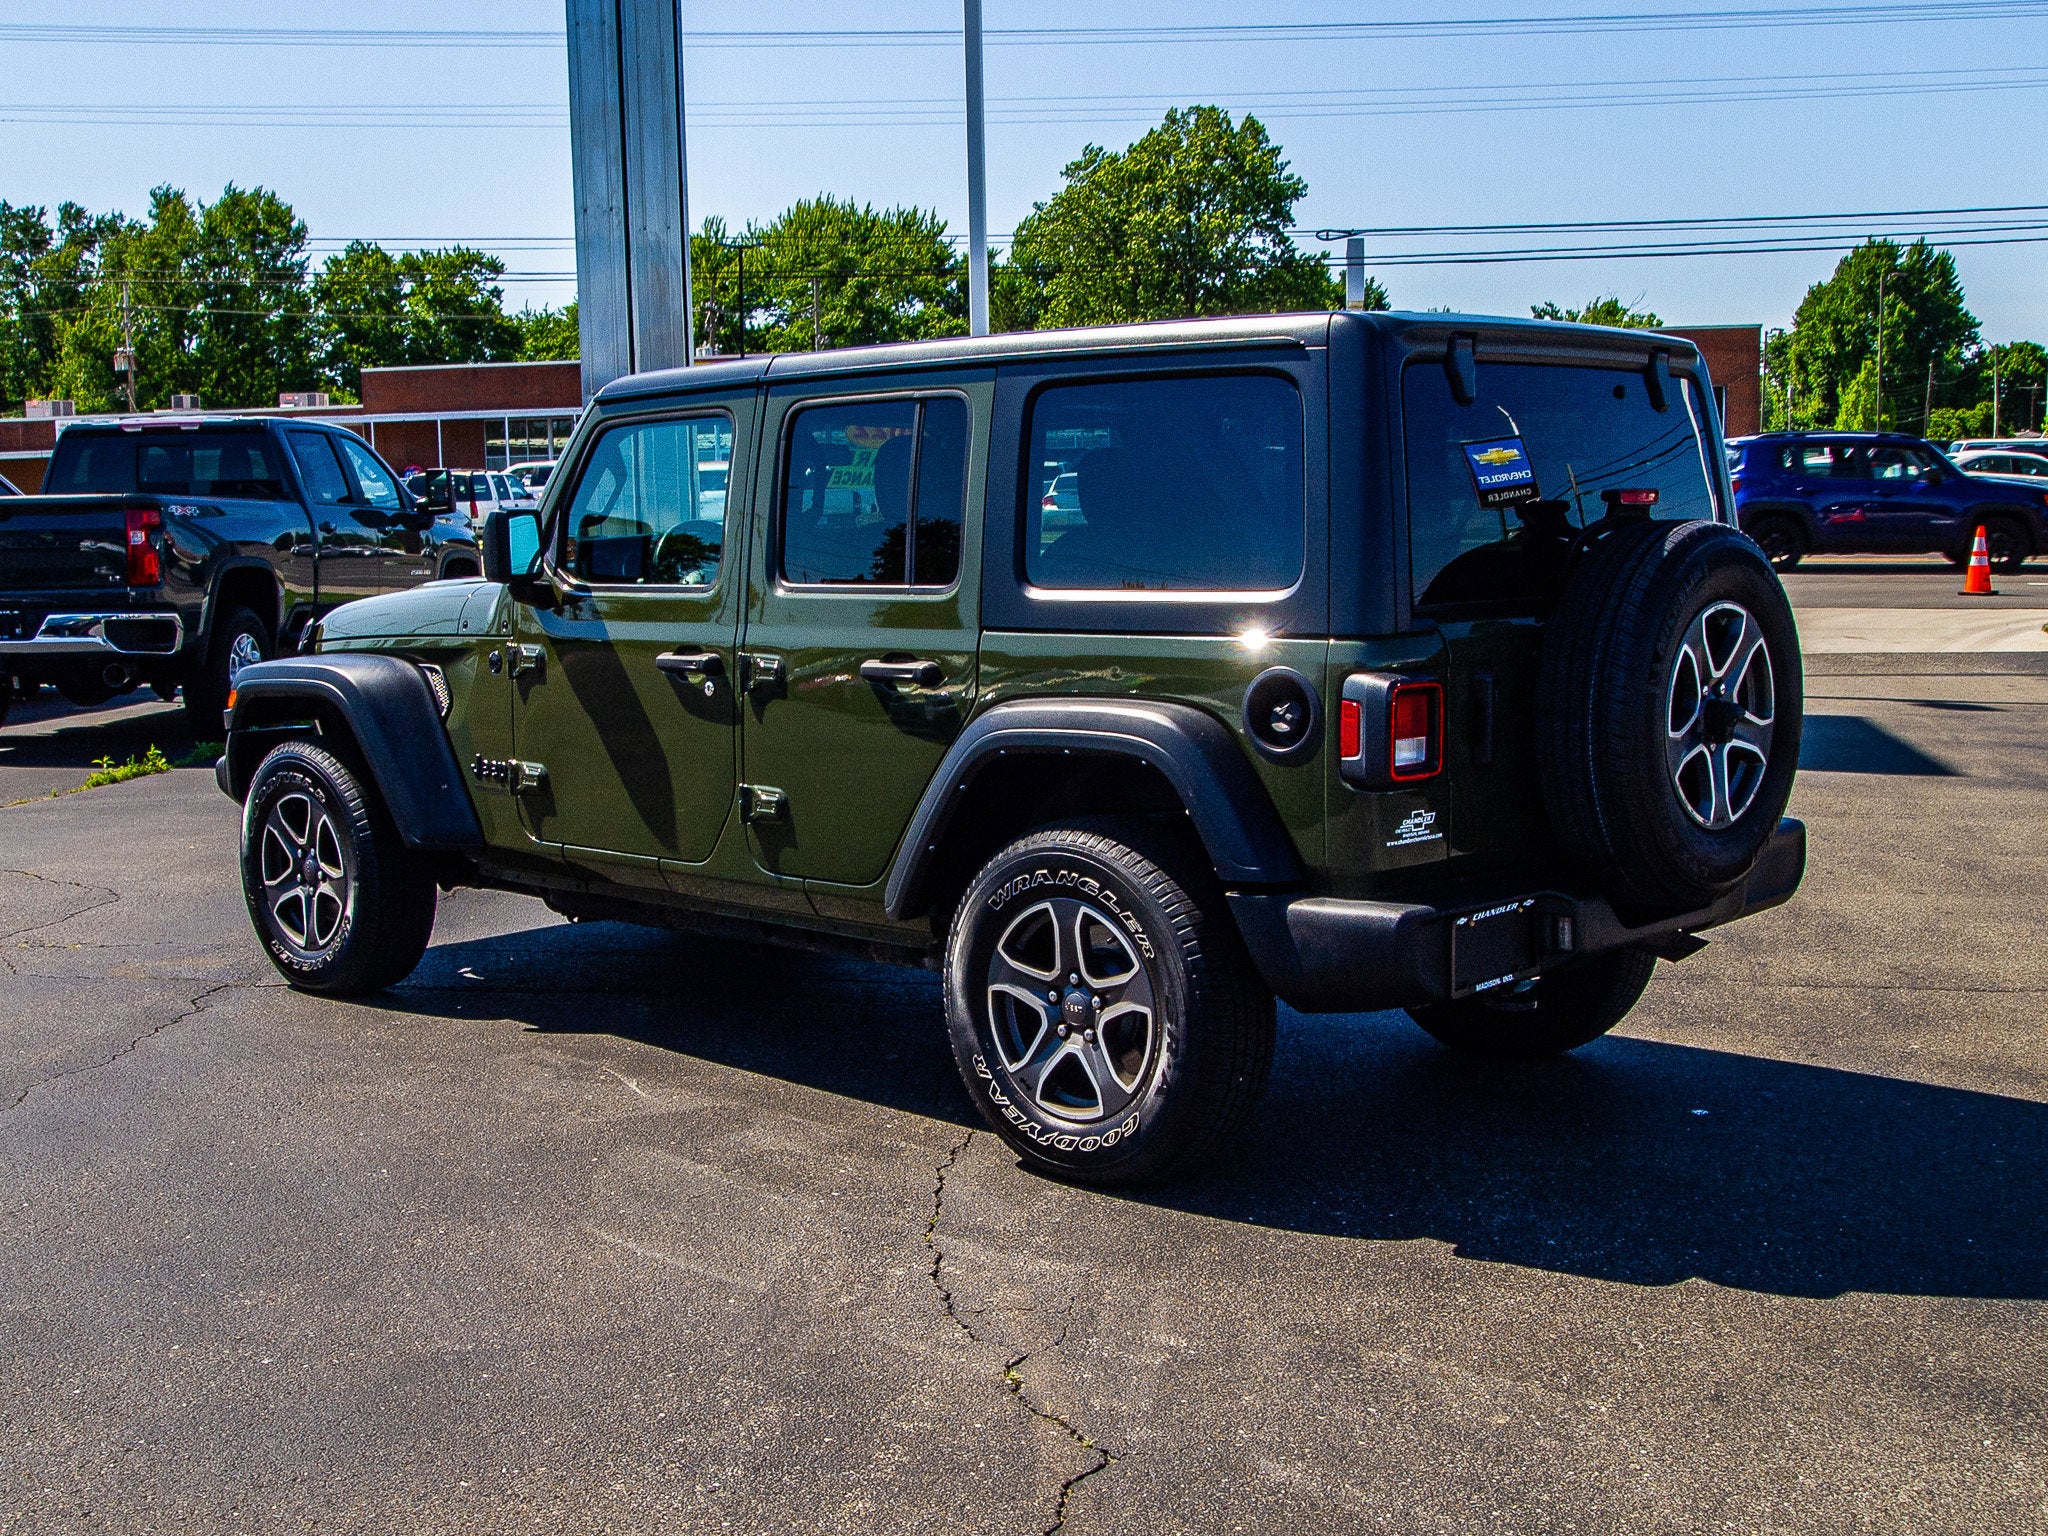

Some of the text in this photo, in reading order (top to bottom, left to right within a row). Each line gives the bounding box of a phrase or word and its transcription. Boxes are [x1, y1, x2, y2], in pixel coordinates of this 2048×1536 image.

[988, 869, 1155, 959] WRANGLER
[1472, 902, 1519, 921] CHANDLER
[972, 1054, 1140, 1152] GOODYEAR
